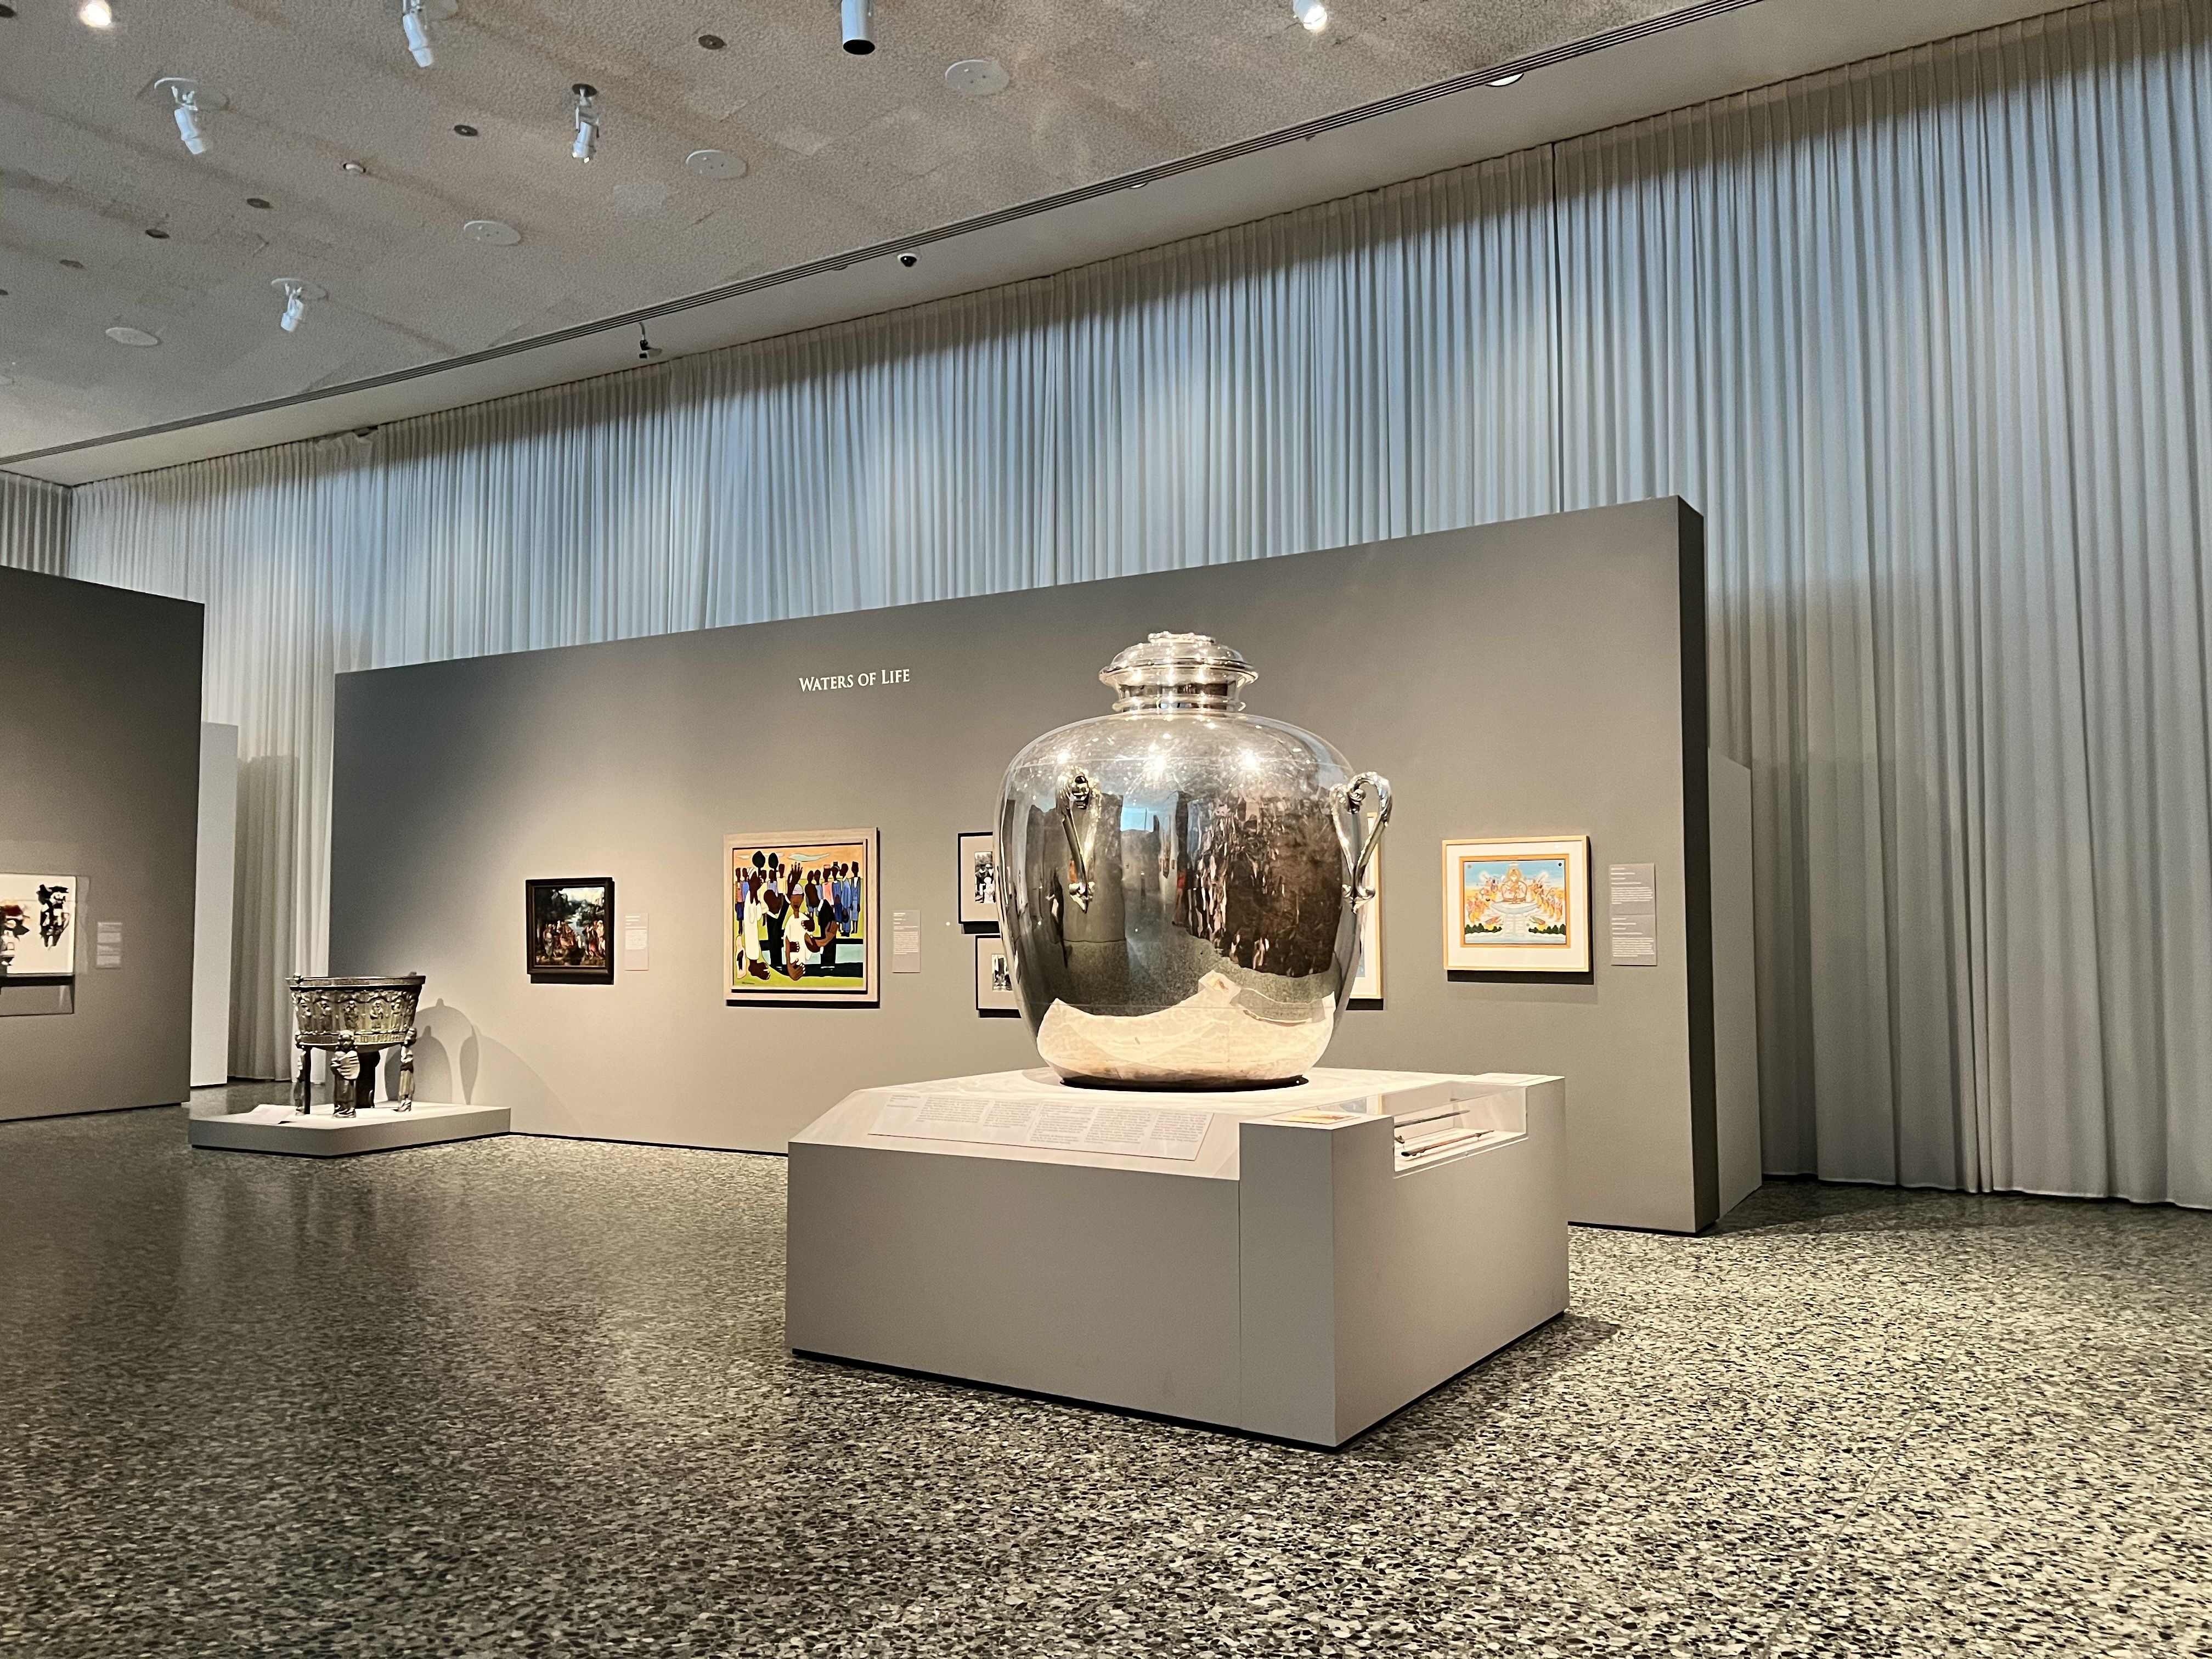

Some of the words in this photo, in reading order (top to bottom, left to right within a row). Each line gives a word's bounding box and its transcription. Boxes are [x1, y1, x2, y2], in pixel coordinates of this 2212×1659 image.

[798, 675, 854, 692] WATERS
[857, 672, 876, 687] OF
[881, 669, 910, 685] LIFE
